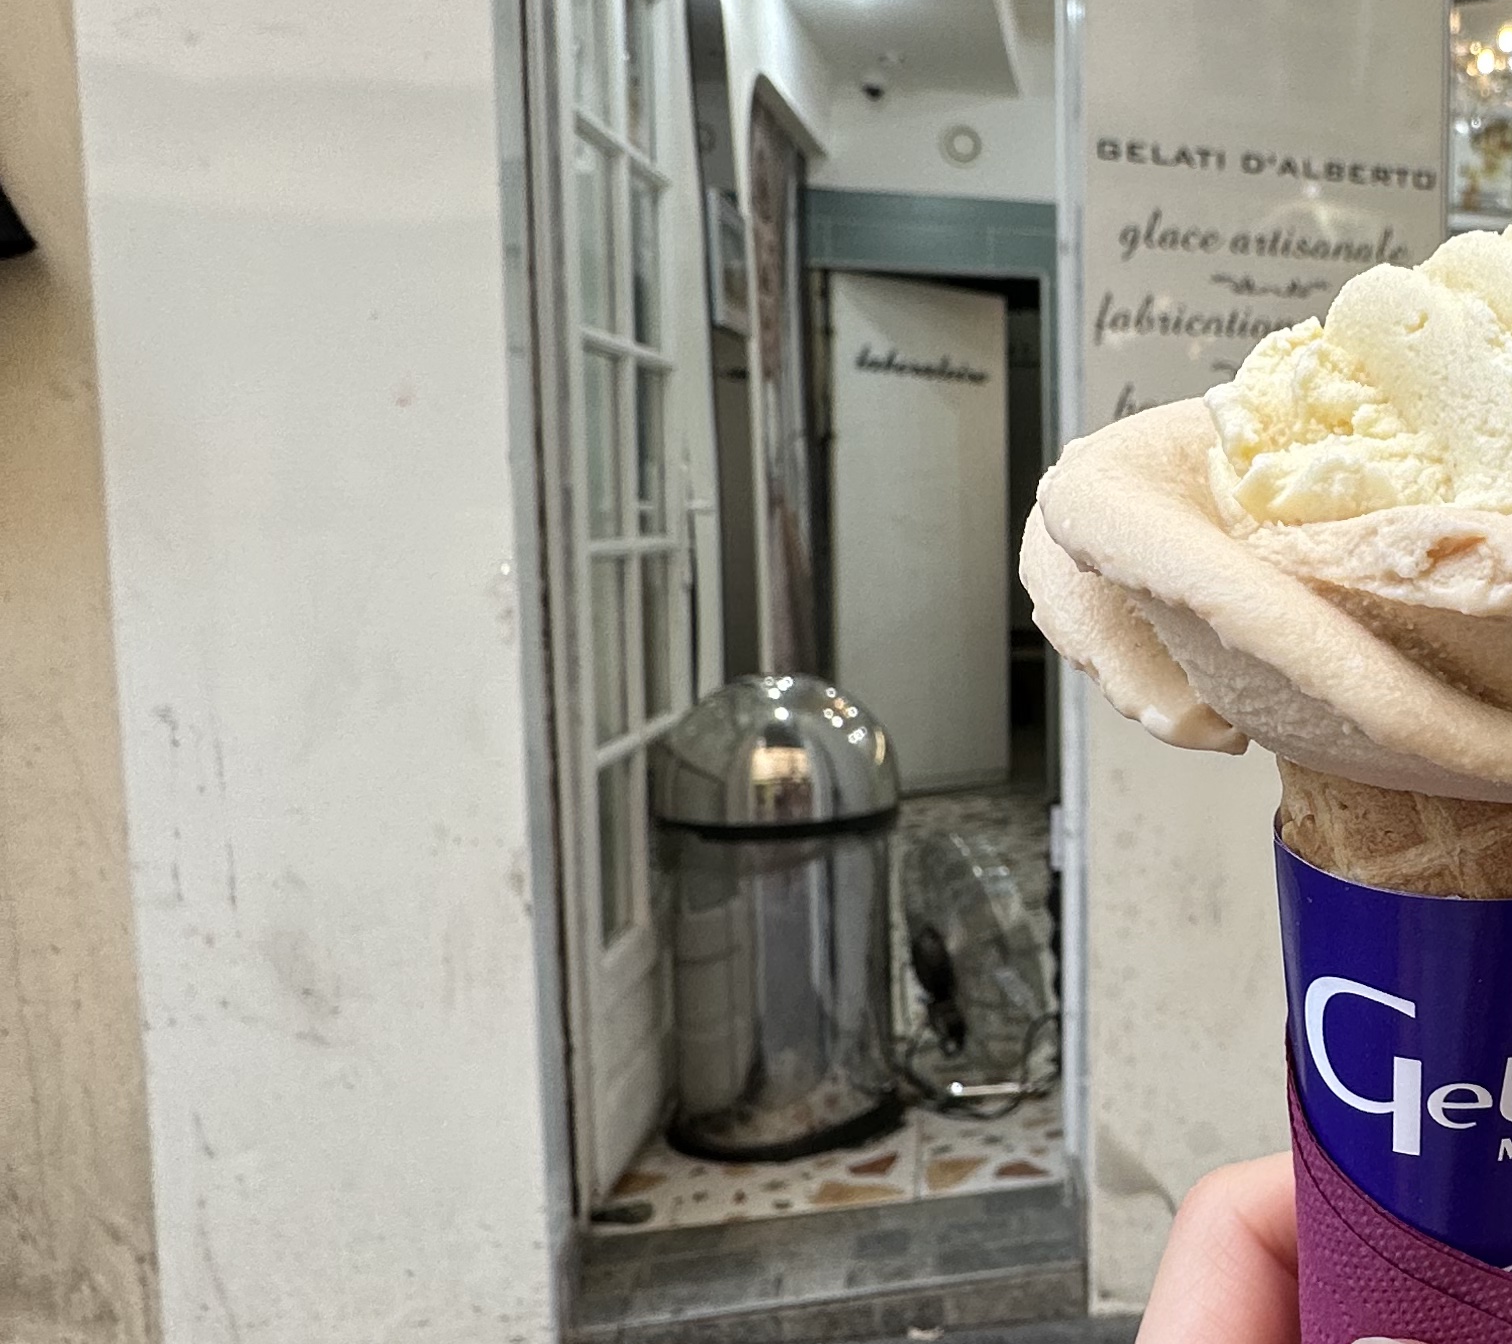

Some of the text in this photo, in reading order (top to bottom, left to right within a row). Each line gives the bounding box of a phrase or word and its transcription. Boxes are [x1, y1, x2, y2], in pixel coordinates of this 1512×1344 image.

[1096, 137, 1438, 191] GELATI D'ALBERTO
[1119, 207, 1409, 262] glace artisanale
